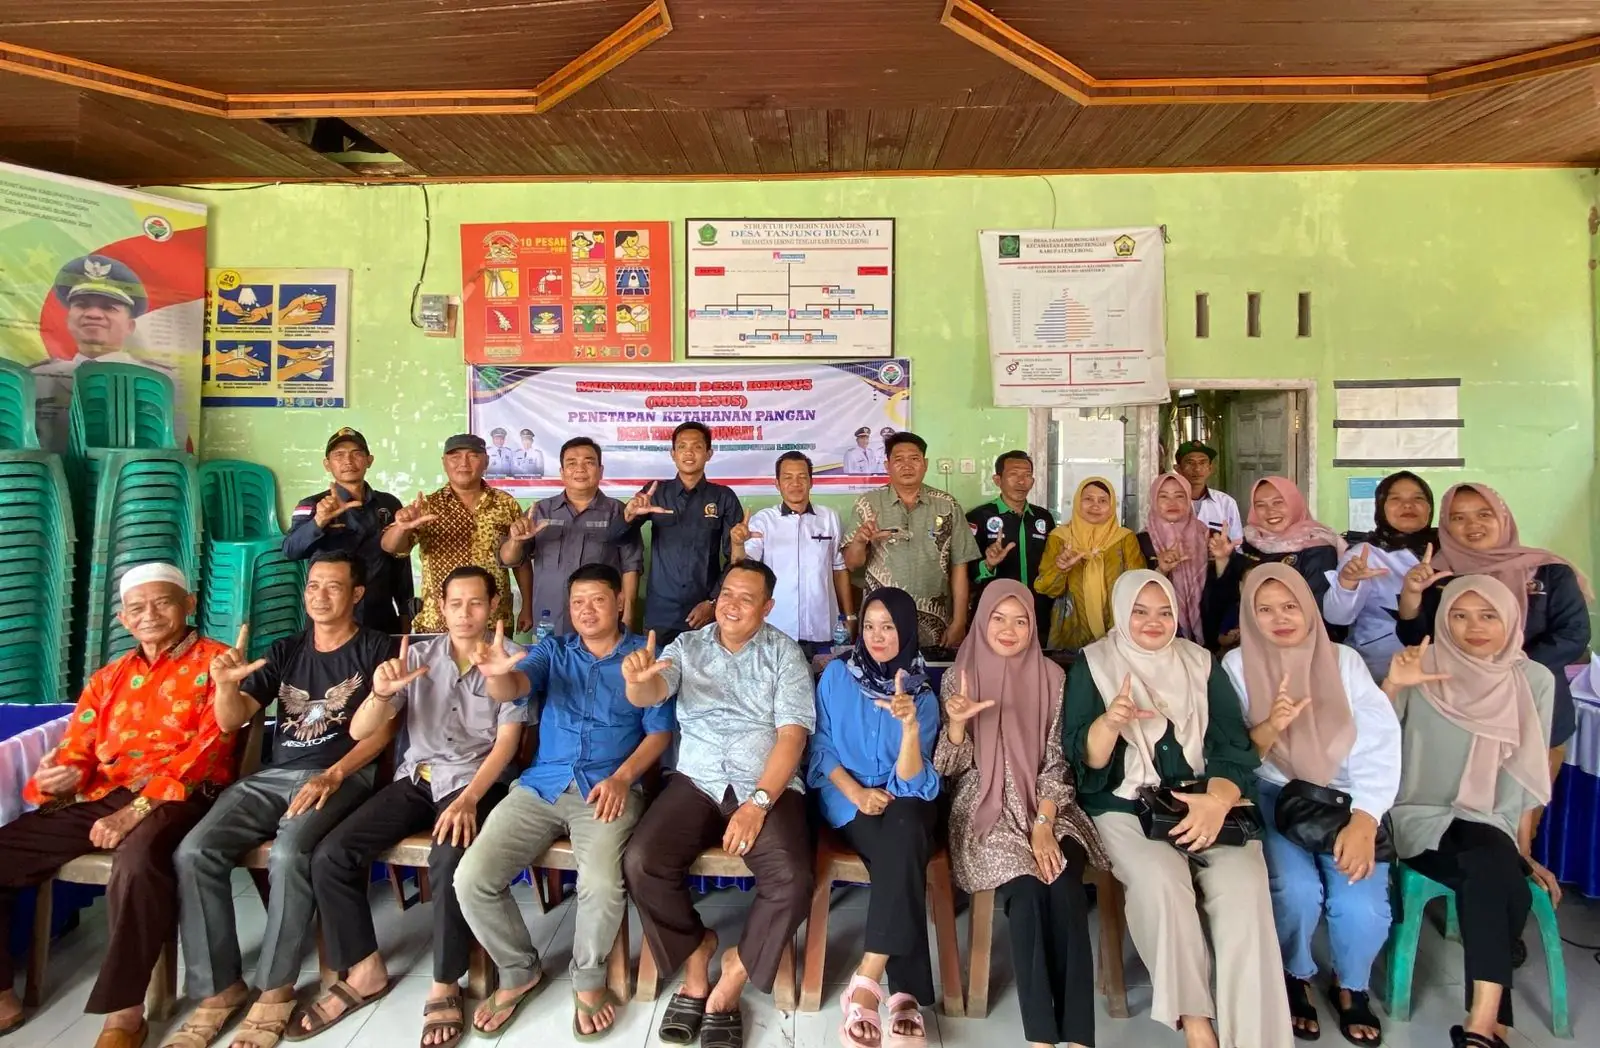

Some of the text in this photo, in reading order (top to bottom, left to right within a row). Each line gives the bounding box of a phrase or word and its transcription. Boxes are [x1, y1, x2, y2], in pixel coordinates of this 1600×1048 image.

[730, 230, 761, 238] DESA
[766, 229, 822, 237] TANJUNG
[520, 236, 567, 247] 10 PESAN
[223, 274, 235, 283] 20
[699, 381, 745, 391] DESA
[747, 379, 813, 391] KHUSUS
[645, 394, 748, 409] (MUSDESUS)
[568, 409, 816, 422] PENETAPAN KETAHANAN PANGAN
